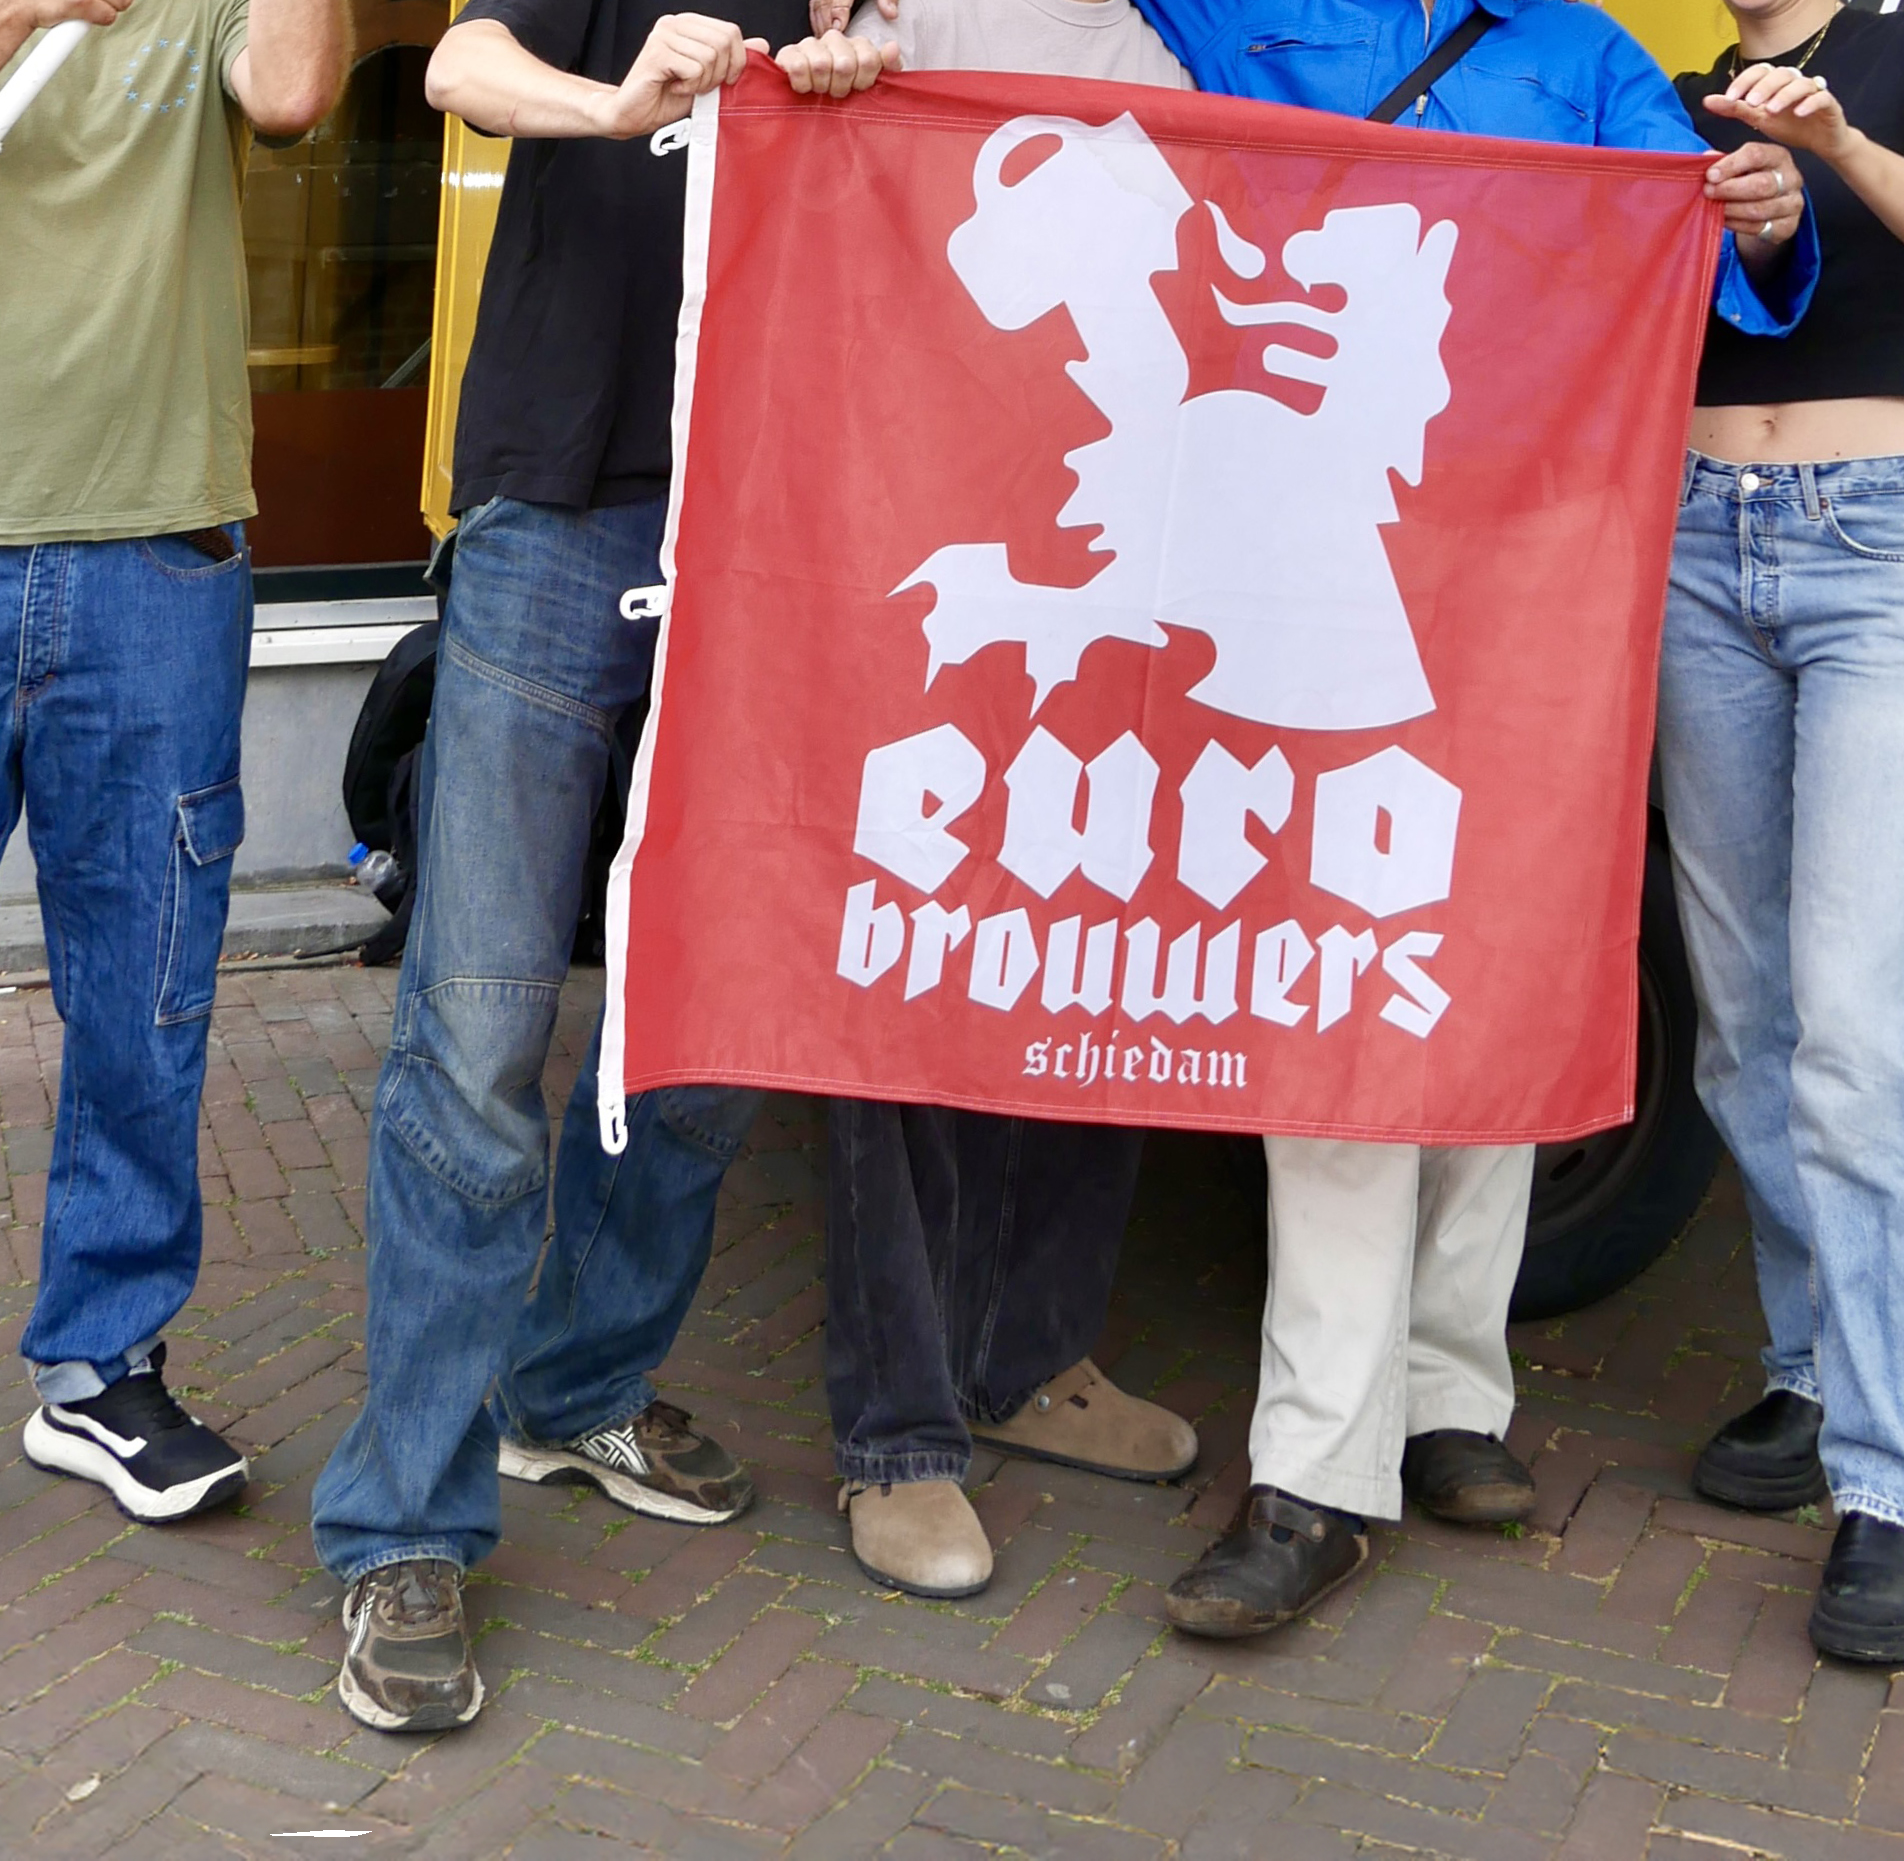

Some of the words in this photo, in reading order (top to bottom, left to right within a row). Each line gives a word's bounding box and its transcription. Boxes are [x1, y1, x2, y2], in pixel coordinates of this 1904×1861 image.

[853, 722, 1462, 919] euro
[836, 878, 1452, 1039] brouwers
[1022, 1030, 1248, 1089] schiedam
